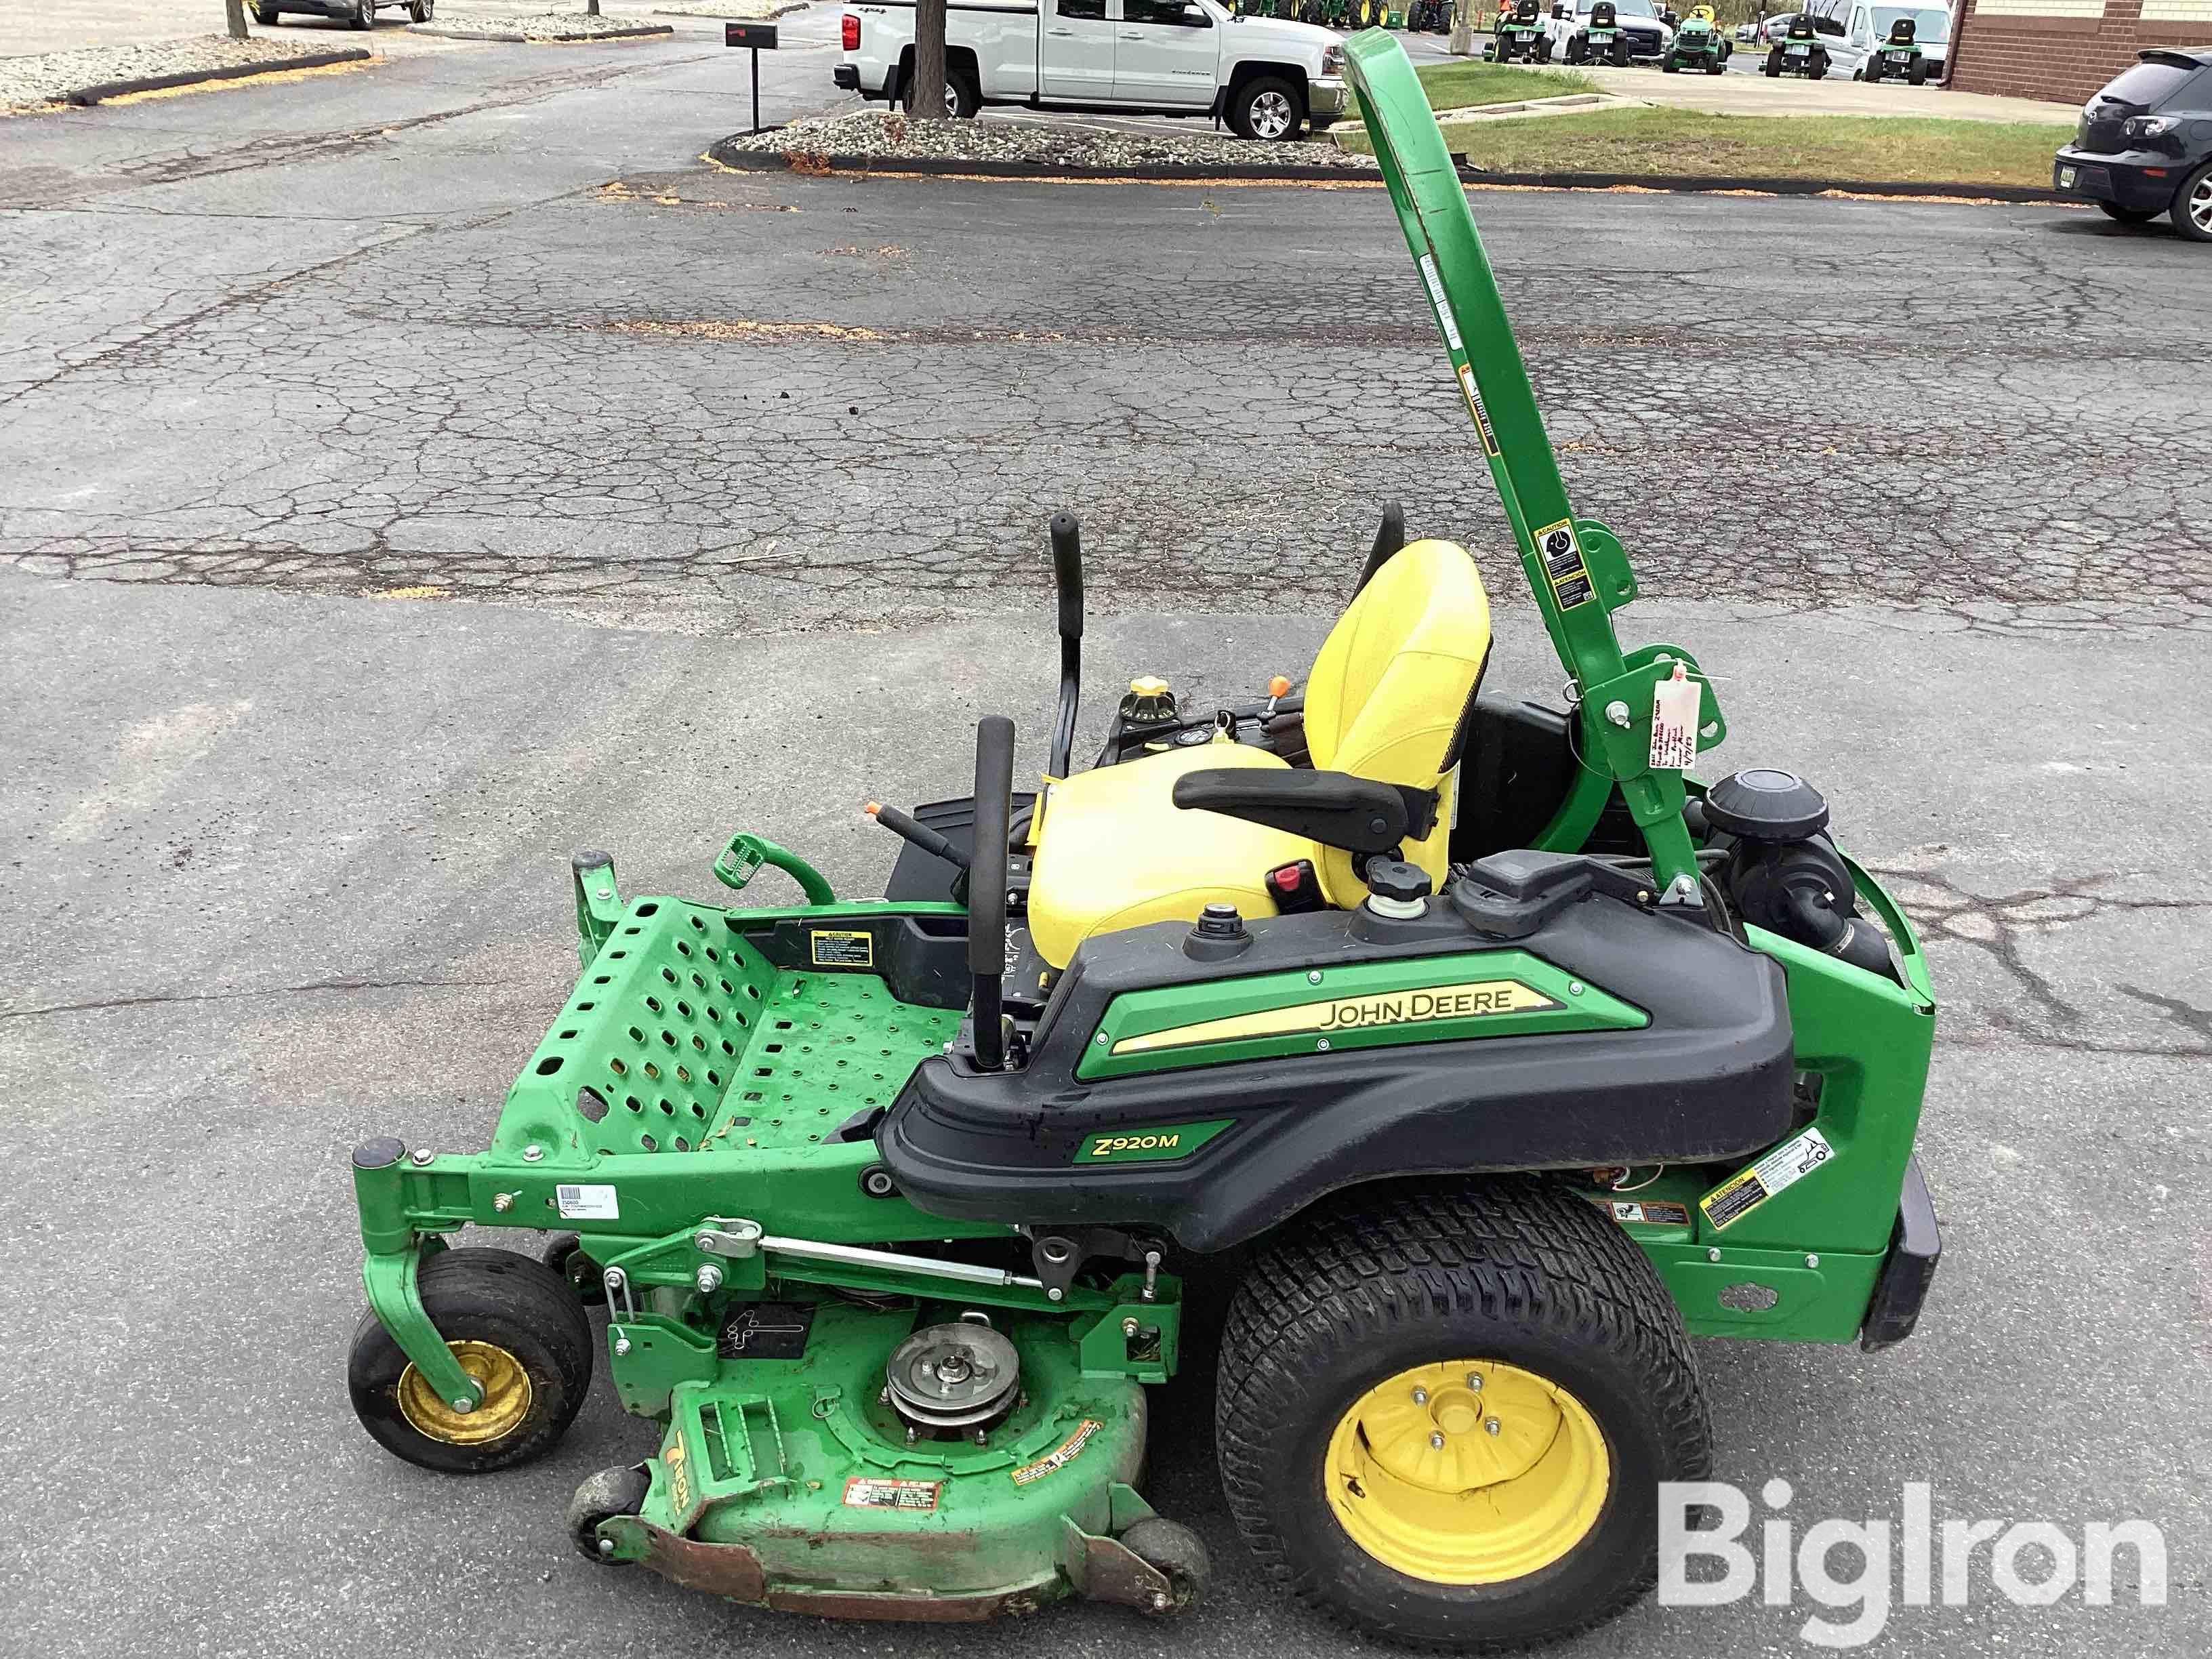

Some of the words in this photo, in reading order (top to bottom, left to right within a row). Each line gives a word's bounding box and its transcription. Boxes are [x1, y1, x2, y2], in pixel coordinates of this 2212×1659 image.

[1542, 520, 1568, 534] CAUTION
[1319, 1000, 1402, 1027] JOHN
[1411, 989, 1513, 1017] DEERE
[1091, 1134, 1179, 1155] Z920M
